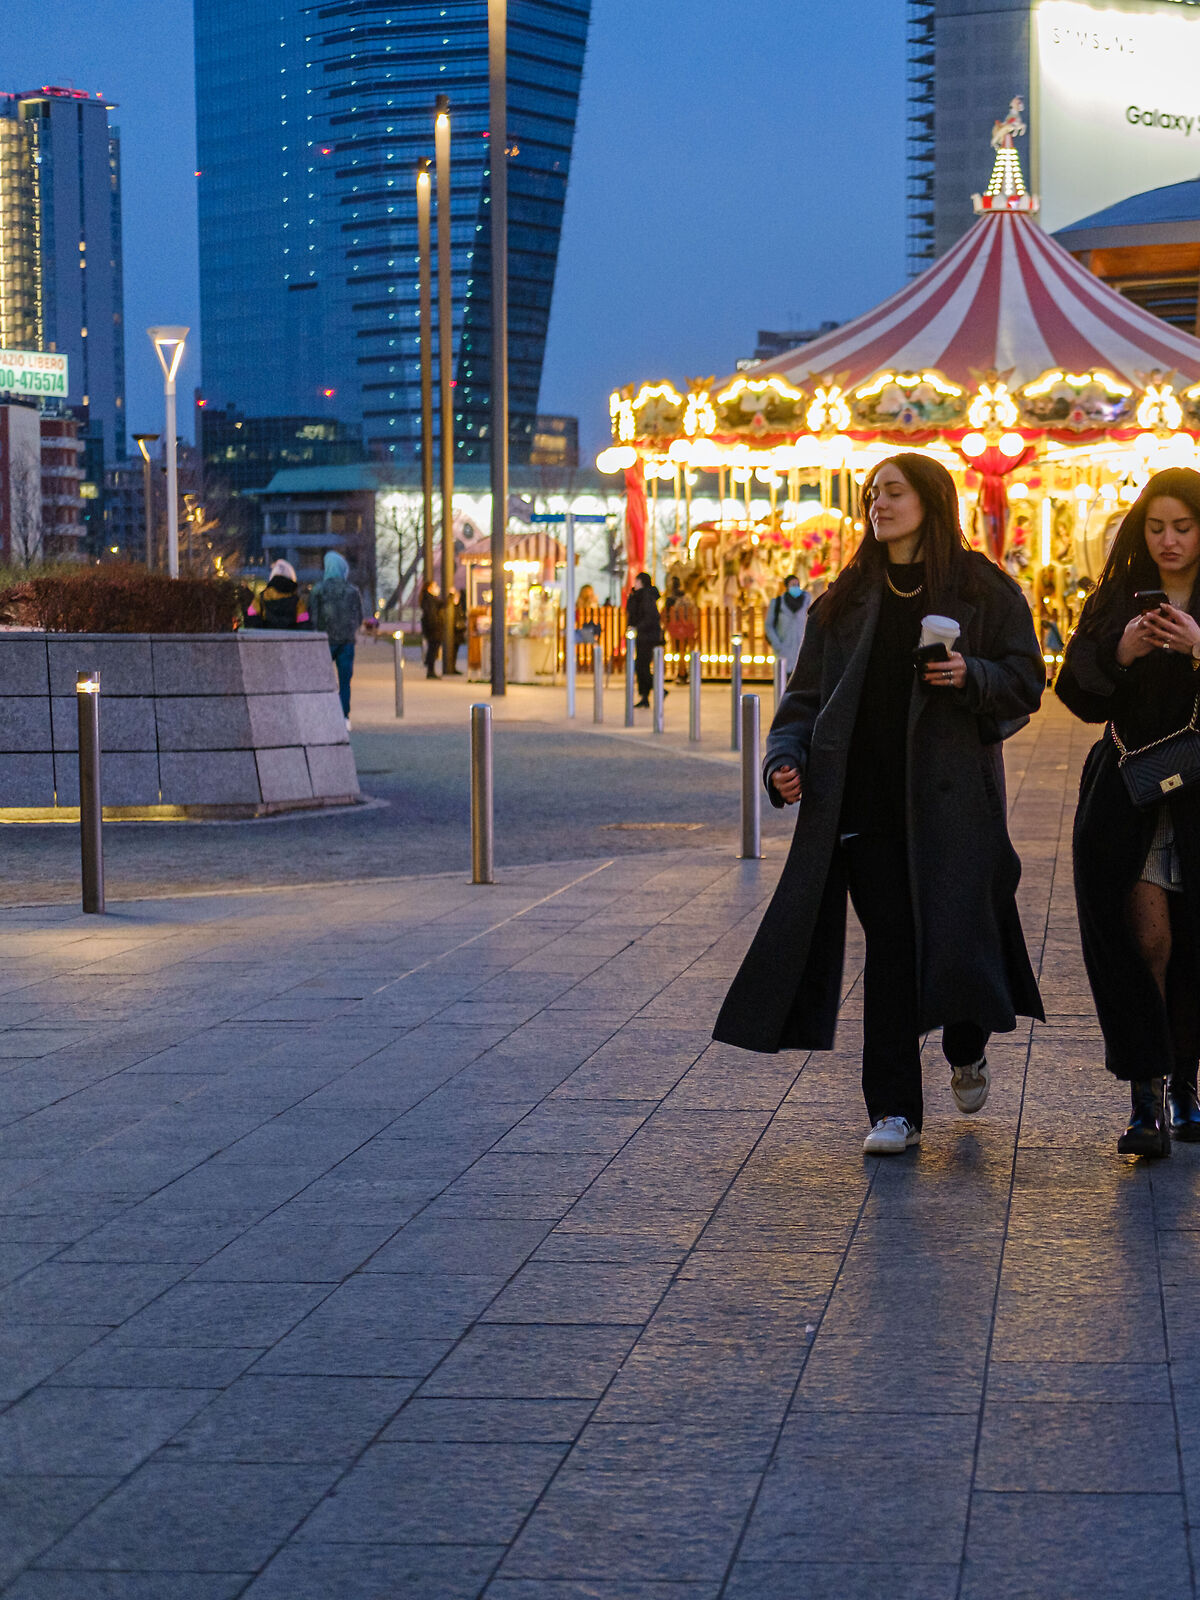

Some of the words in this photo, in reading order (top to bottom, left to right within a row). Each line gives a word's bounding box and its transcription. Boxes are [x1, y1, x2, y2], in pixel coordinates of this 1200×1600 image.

[1126, 105, 1194, 137] Galaxy
[0, 353, 25, 367] AZIO
[28, 355, 65, 371] LIBERO
